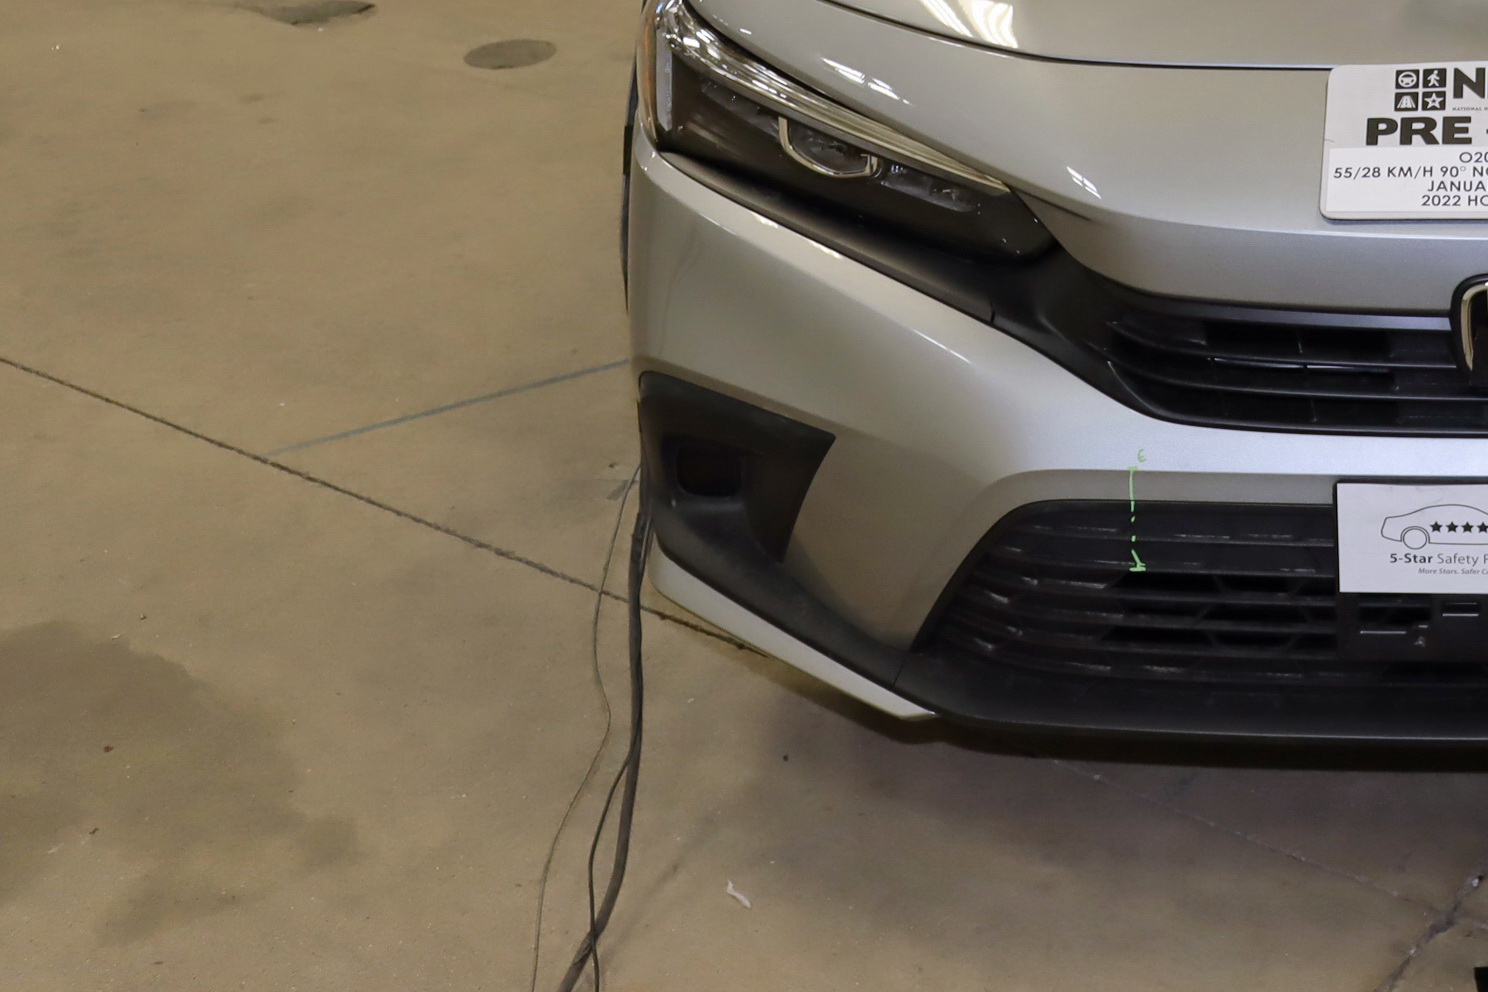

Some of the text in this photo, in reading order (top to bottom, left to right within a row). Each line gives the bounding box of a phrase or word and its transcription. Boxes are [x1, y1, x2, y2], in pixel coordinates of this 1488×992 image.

[1366, 116, 1472, 146] PRE
[1333, 166, 1381, 179] 55/28
[1387, 165, 1434, 178] KM/H
[1440, 165, 1467, 178] 90°
[1421, 194, 1461, 207] 2022
[1390, 553, 1433, 563] 5-Star
[1437, 553, 1478, 566] Safety
